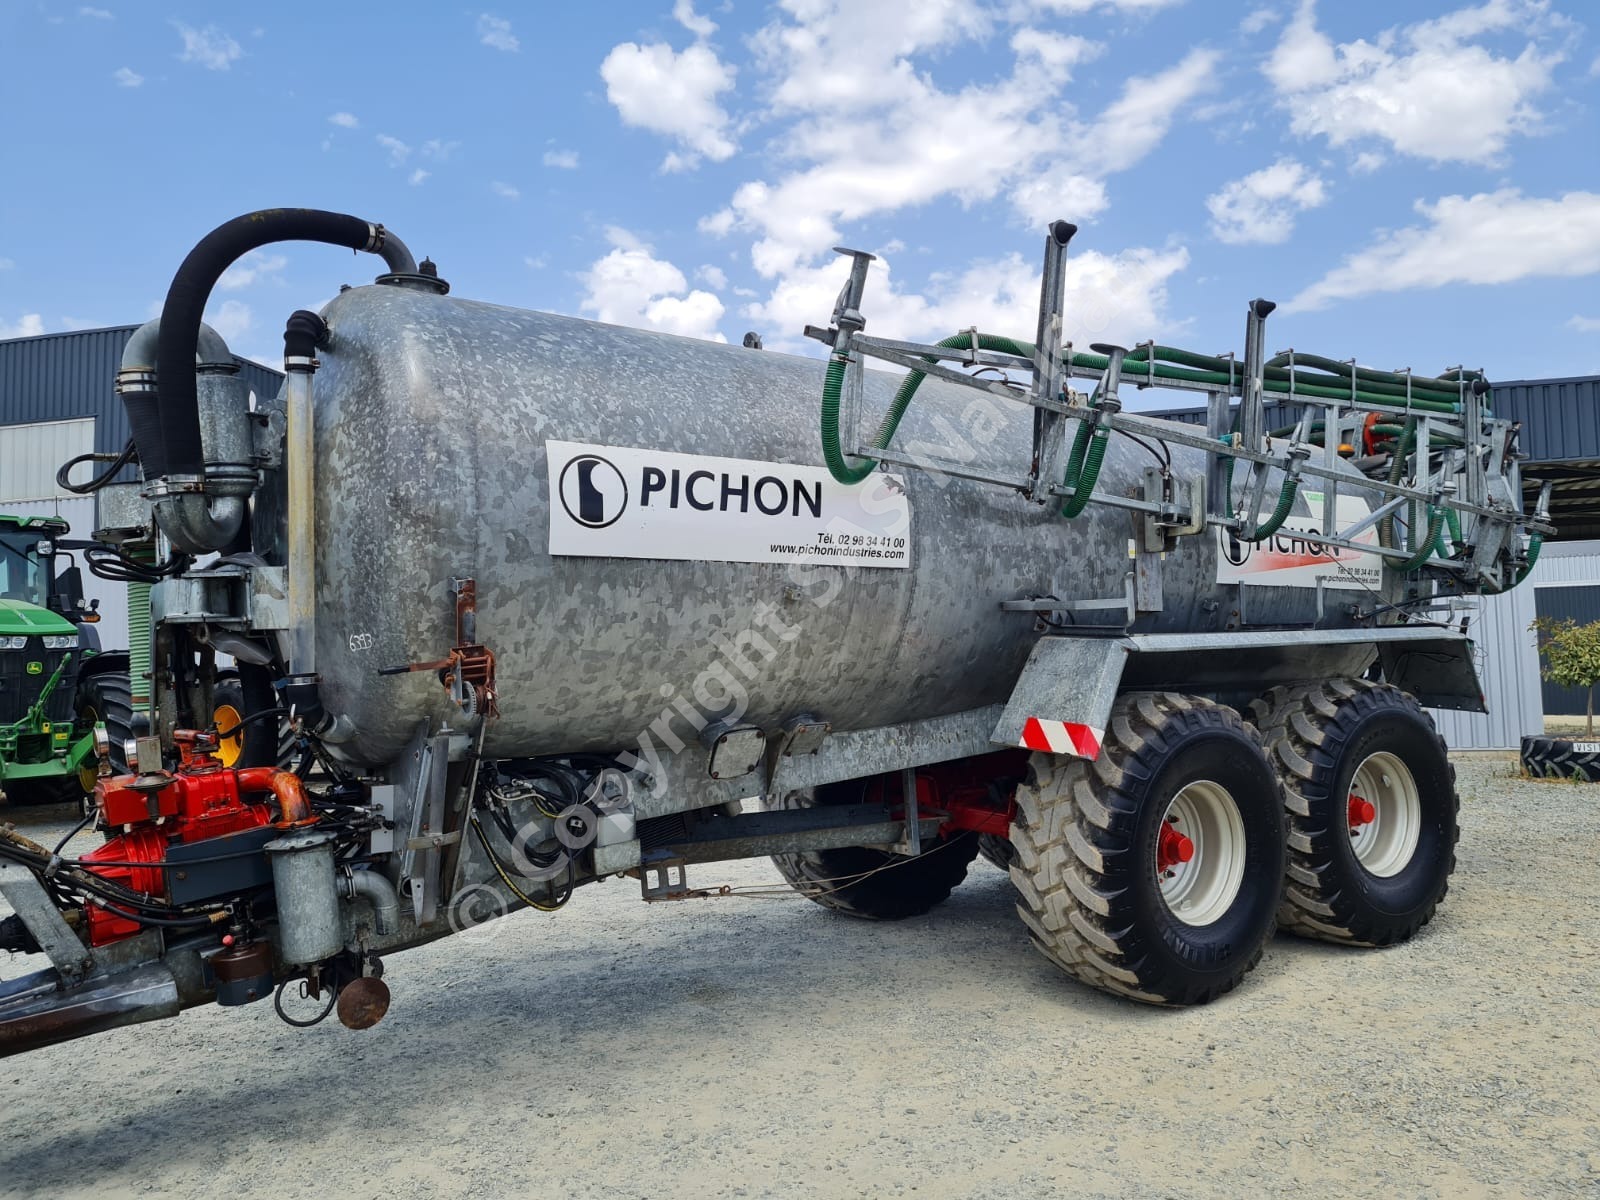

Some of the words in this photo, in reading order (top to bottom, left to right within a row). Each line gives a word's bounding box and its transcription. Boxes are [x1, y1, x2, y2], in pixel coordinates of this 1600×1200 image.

[640, 466, 822, 518] PICHON
[818, 533, 834, 544] Tél.
[838, 534, 850, 545] 02
[852, 535, 864, 546] 98
[866, 536, 878, 546] 34
[880, 537, 891, 547] 41
[893, 538, 905, 548] 00
[770, 544, 905, 559] www.pichonindustries.com
[1576, 743, 1600, 752] VISI
